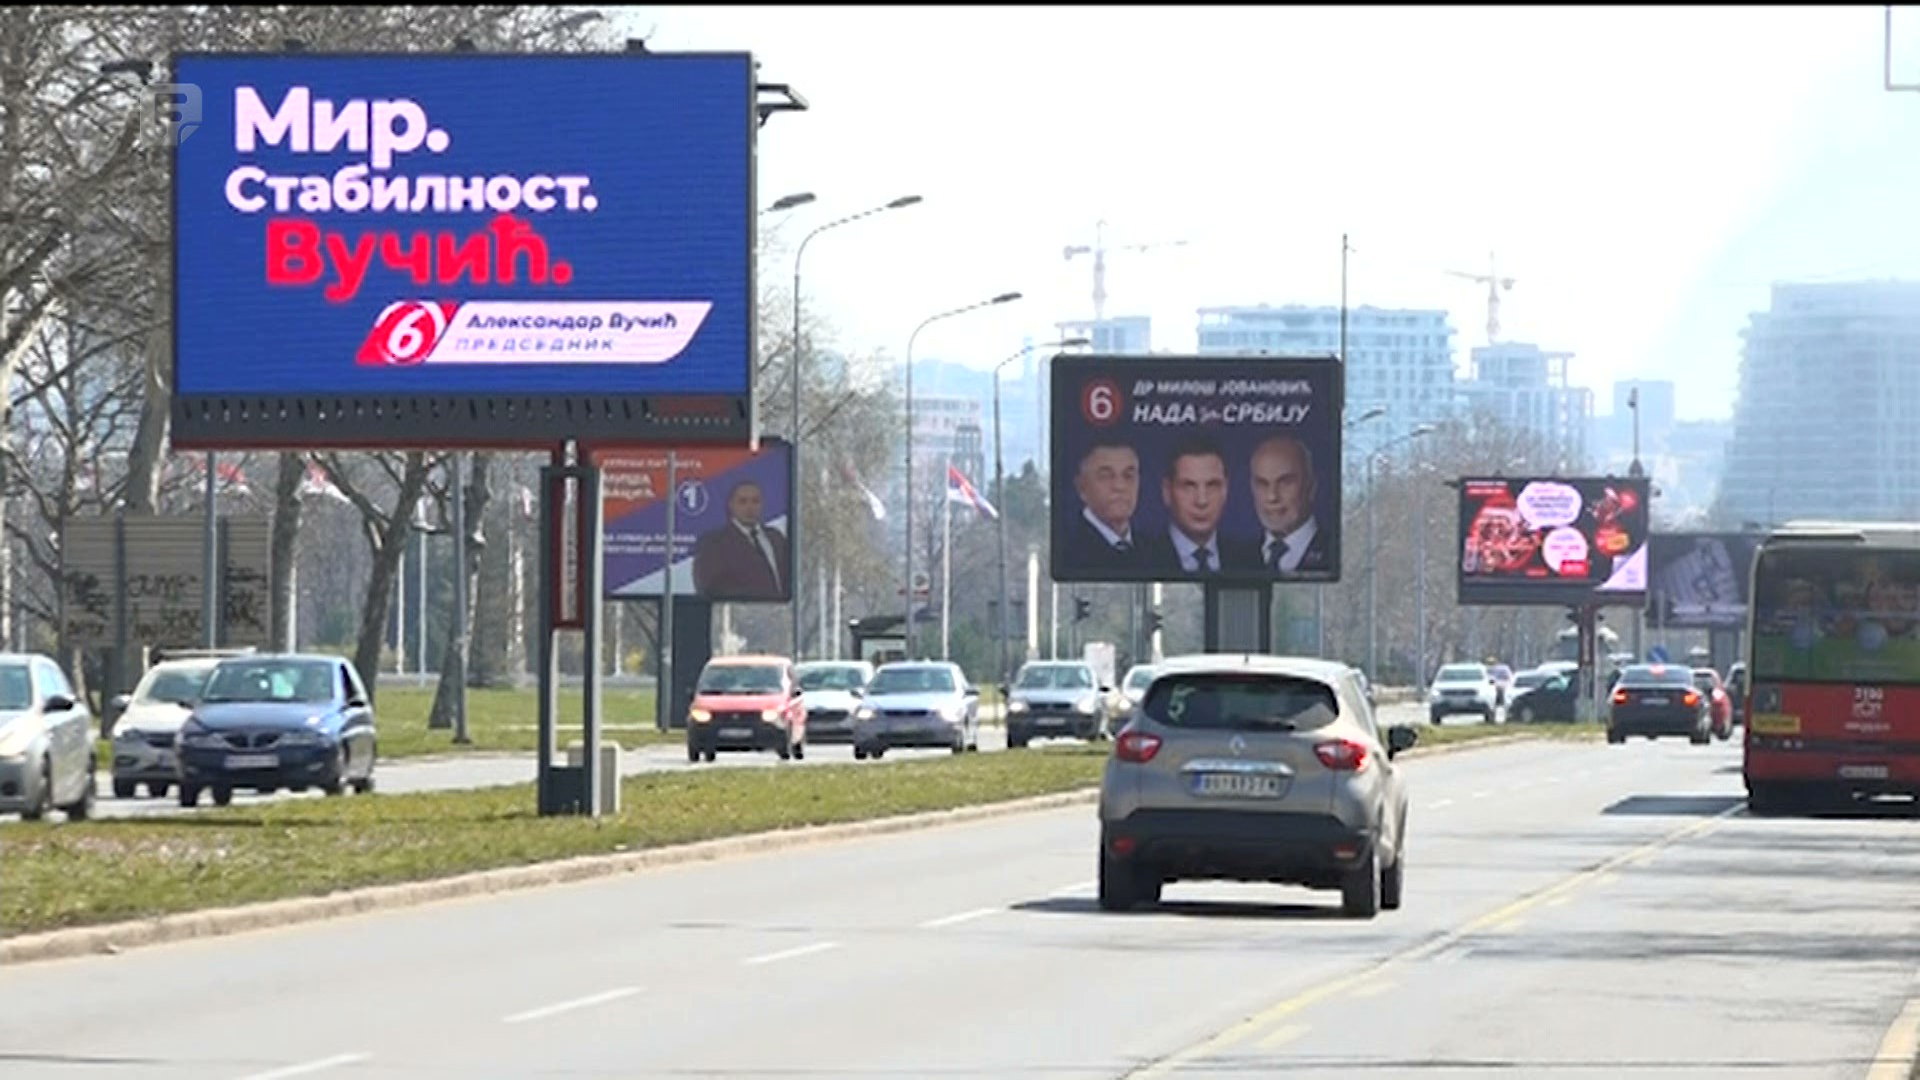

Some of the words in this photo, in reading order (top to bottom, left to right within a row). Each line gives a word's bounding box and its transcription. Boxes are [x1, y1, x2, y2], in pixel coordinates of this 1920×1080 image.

[234, 86, 450, 169] Мир.
[225, 164, 599, 212] Стабилност.
[265, 212, 573, 301] Вучић.
[385, 311, 423, 355] 6
[466, 313, 603, 332] Александар
[608, 311, 678, 332] Вучић
[455, 337, 615, 351] ПРЕДСЕДНИК
[1089, 386, 1114, 420] 6
[1132, 402, 1197, 424] НАДА
[1222, 402, 1311, 423] СРБИЈУ
[683, 485, 697, 509] 1
